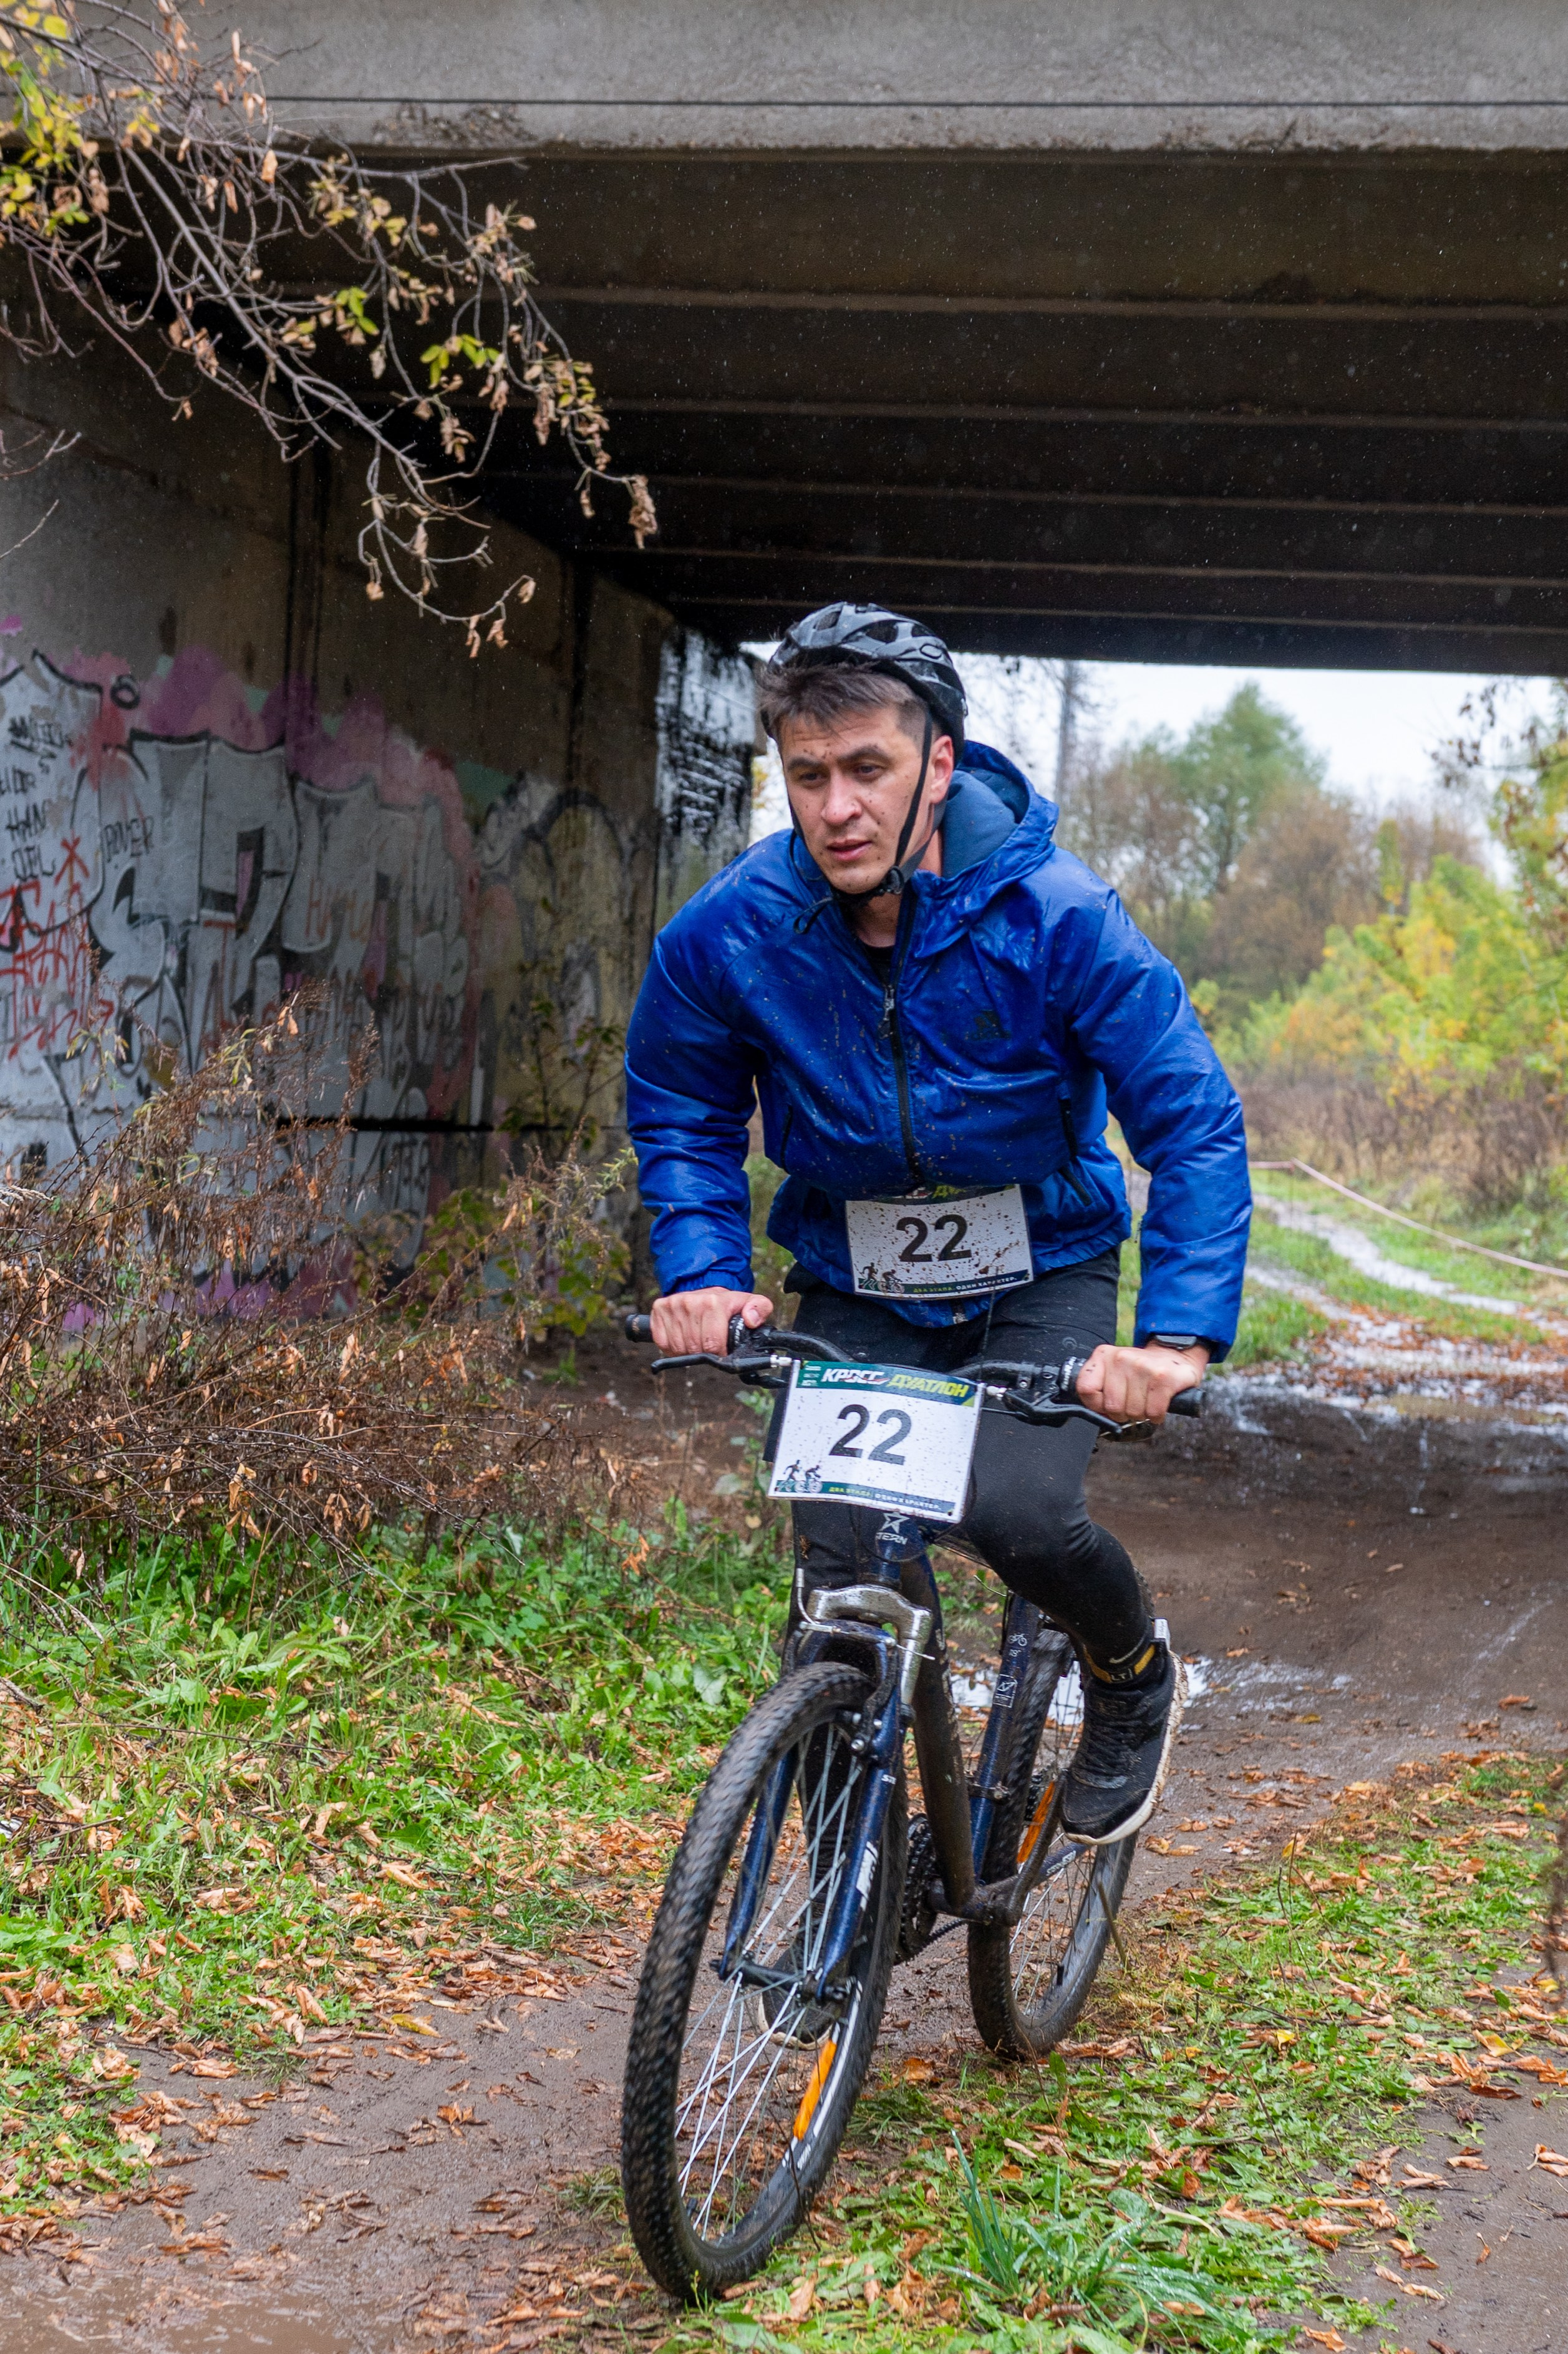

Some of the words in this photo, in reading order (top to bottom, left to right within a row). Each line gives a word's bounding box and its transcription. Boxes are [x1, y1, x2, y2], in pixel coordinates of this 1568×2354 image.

[896, 1214, 972, 1262] 22
[821, 1368, 891, 1385] КРОСС
[886, 1373, 970, 1398] ДУАТЛОН
[828, 1403, 912, 1466] 22
[875, 1532, 908, 1545] TERN
